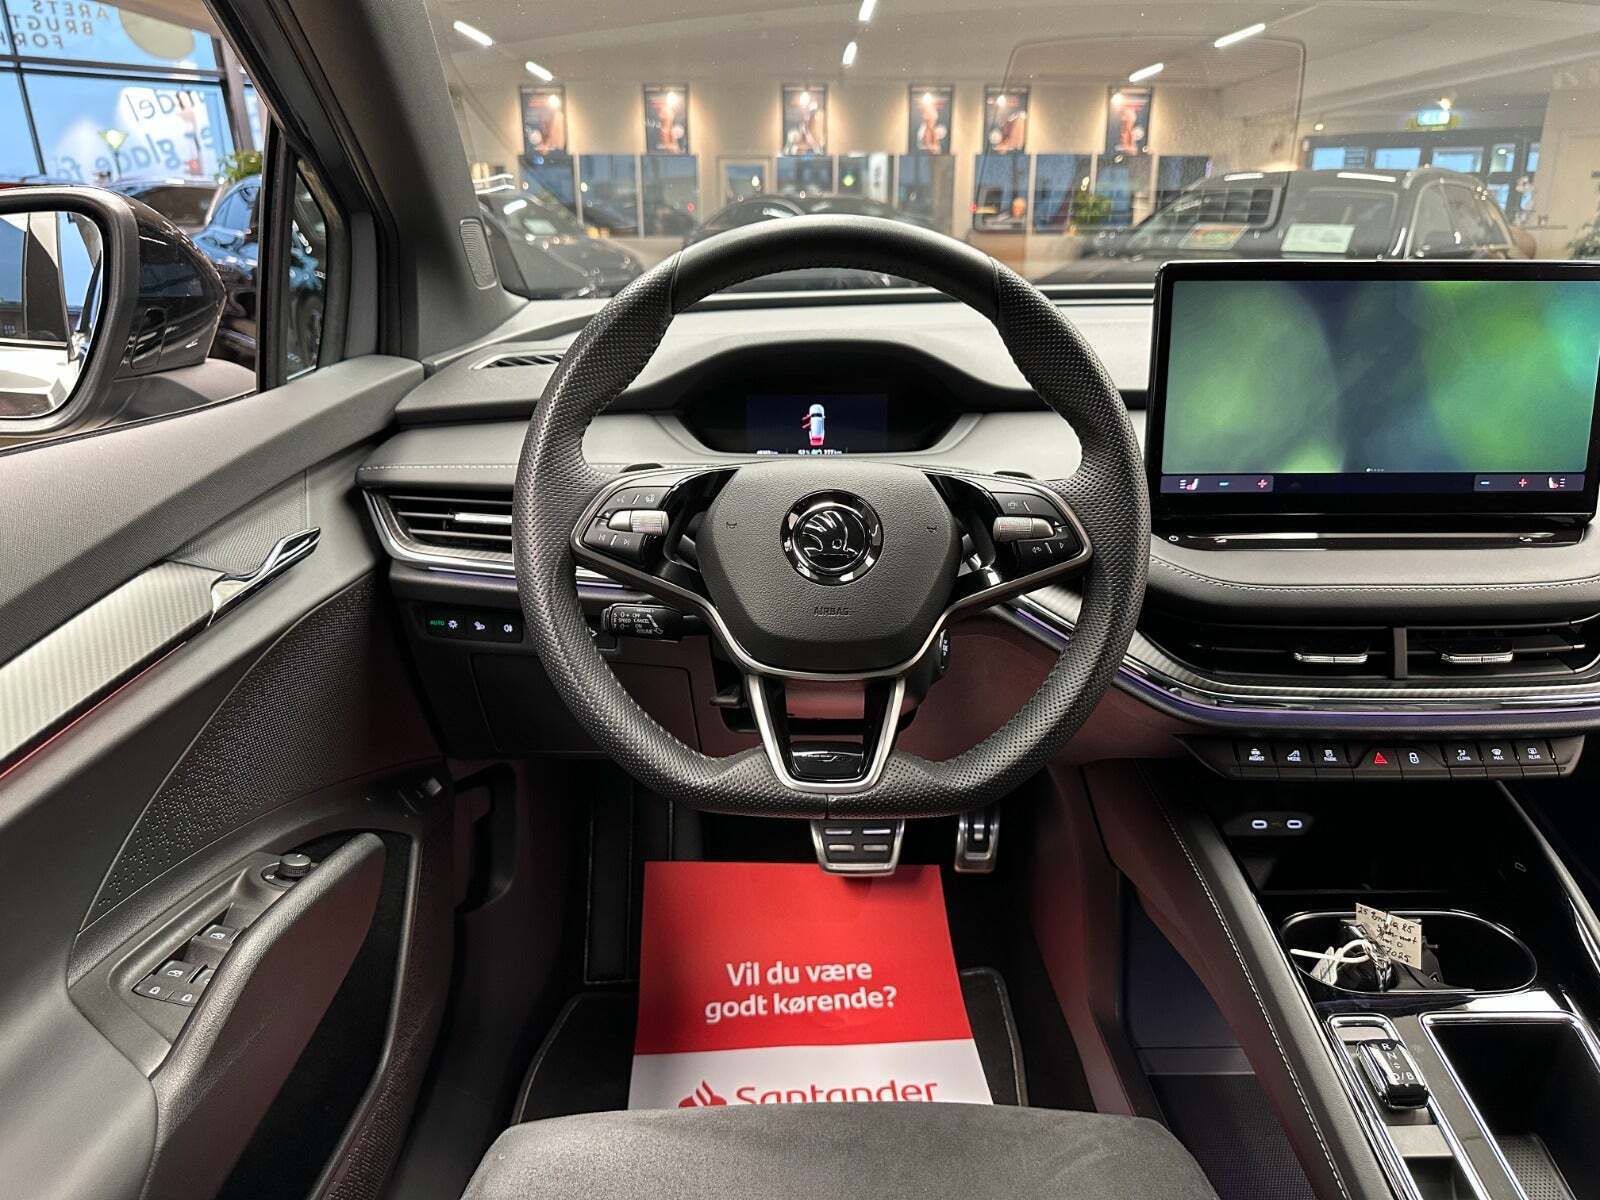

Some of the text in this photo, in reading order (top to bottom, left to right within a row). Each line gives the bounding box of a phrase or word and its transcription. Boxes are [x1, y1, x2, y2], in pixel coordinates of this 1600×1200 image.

[813, 606, 850, 617] AIRBAG
[726, 960, 873, 987] Vil du være
[705, 986, 897, 1024] godt kørende?
[1381, 1042, 1391, 1051] R
[1386, 1051, 1398, 1060] N
[736, 1079, 939, 1105] Santander
